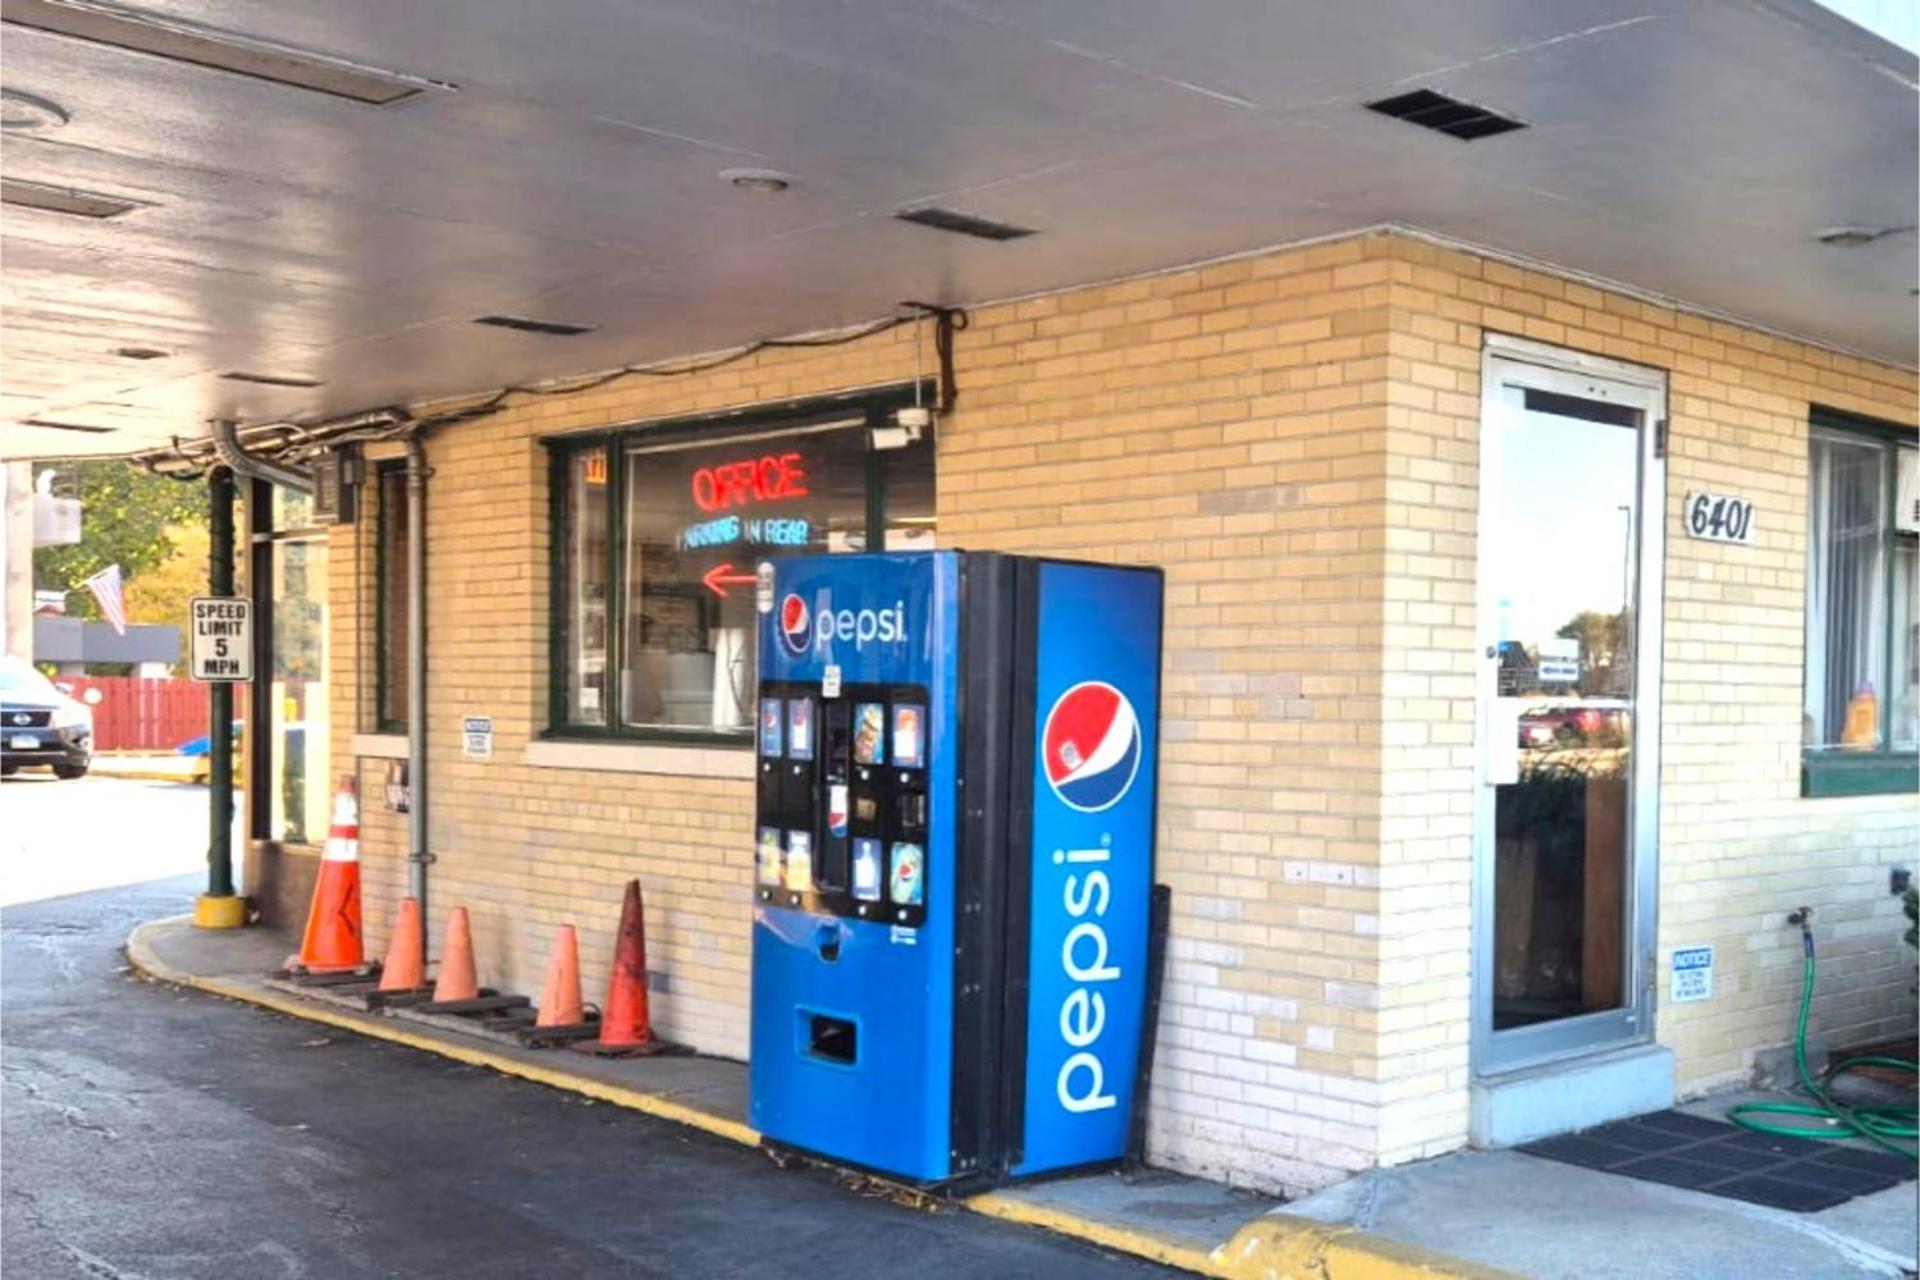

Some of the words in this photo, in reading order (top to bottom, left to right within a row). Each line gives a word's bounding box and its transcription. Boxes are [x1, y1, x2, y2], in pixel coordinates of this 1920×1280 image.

[692, 452, 808, 512] OFFICE
[1691, 494, 1752, 539] 6401
[743, 519, 762, 544] IN
[764, 519, 808, 545] REAR
[196, 603, 246, 619] SPEED
[199, 621, 243, 637] LIMIT
[815, 600, 904, 652] pepsi
[215, 638, 228, 657] 5
[204, 659, 239, 675] MPH
[1674, 952, 1709, 968] NOTICE
[1053, 848, 1121, 1113] pepsi
